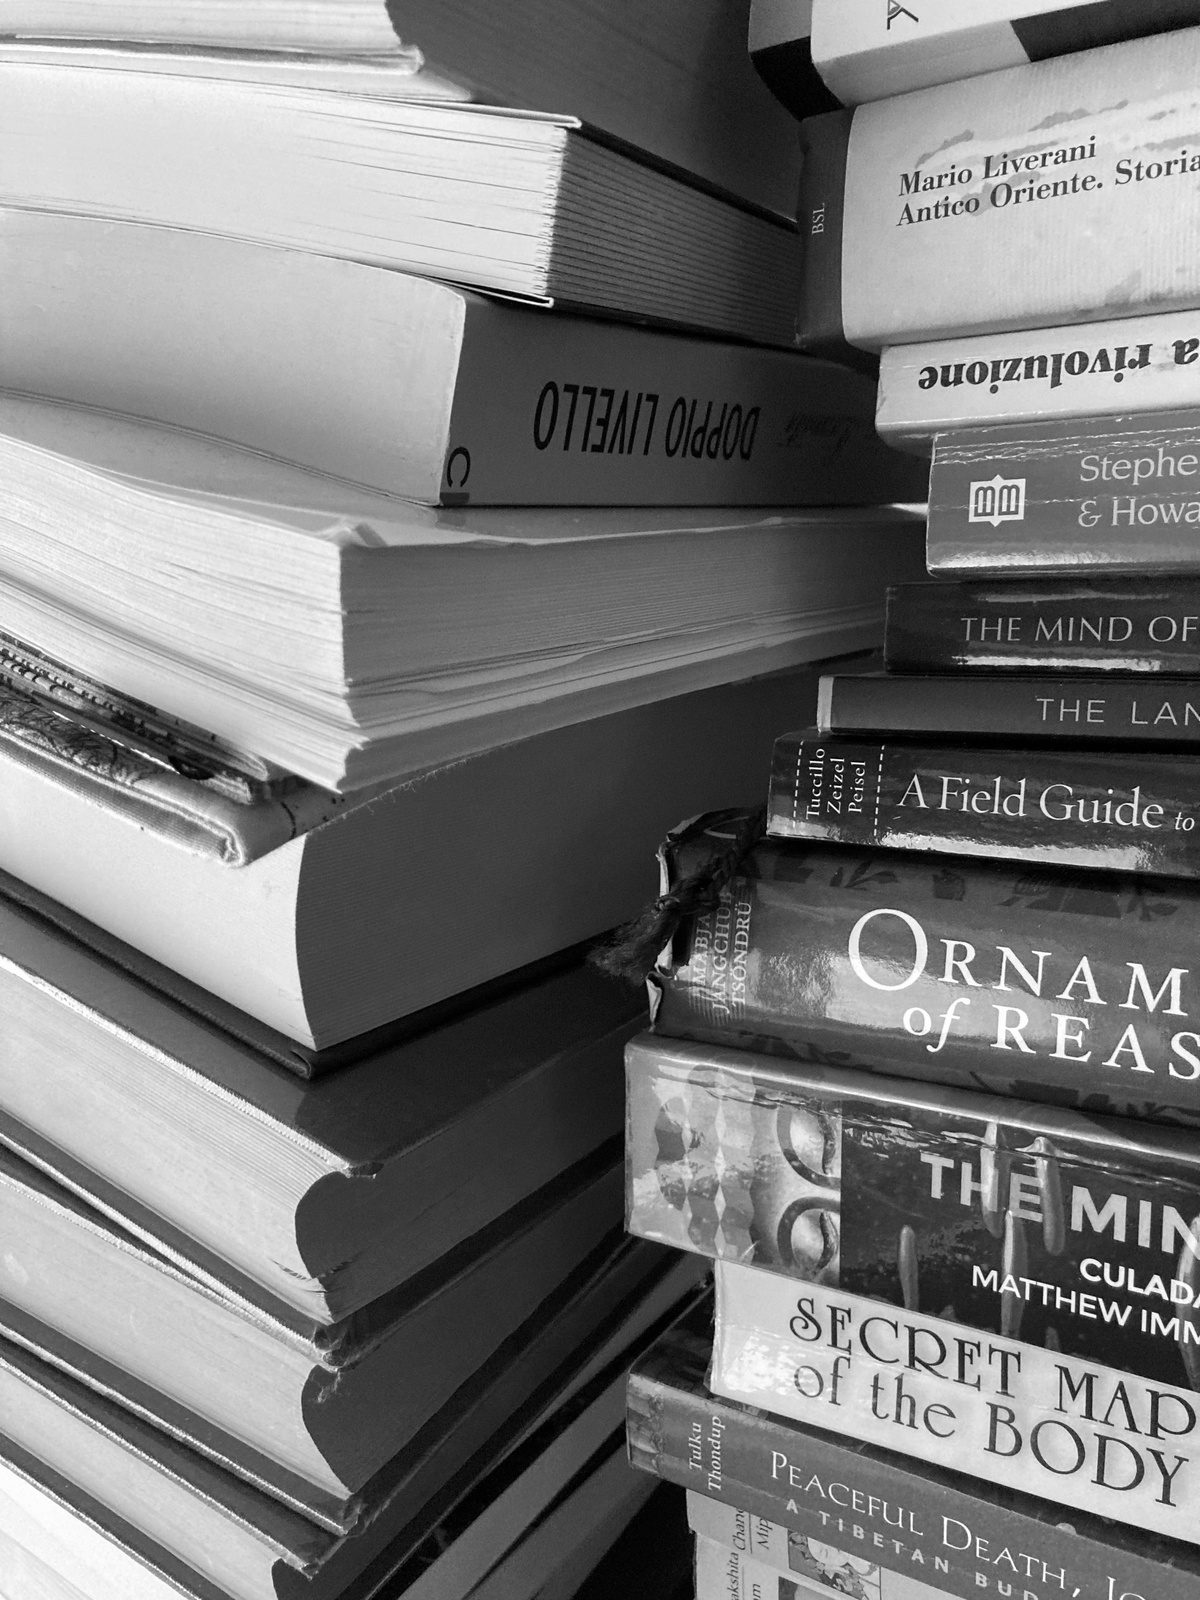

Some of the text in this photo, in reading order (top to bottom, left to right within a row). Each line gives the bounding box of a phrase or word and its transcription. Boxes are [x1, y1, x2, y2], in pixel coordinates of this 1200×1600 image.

[898, 135, 1097, 197] Mario Liverani
[811, 201, 826, 235] BSL
[896, 195, 981, 227] Antico
[989, 174, 1104, 208] Oriente.
[918, 343, 1153, 394] rivoluzione
[533, 381, 660, 457] LIVELLO
[664, 396, 762, 461] DOPPIO
[1080, 447, 1199, 486] Stephe
[1078, 500, 1102, 528] &
[960, 615, 1200, 643] THE MIND OF
[1036, 698, 1106, 723] THE
[805, 747, 826, 820] Tuccillo
[826, 757, 846, 815] Zeizel
[847, 759, 867, 814] Peisel
[897, 773, 1196, 831] A Field Guide to
[730, 901, 752, 1007] TSÖNDRÜ
[848, 908, 1190, 1017] ORNAM
[902, 997, 1200, 1080] of REAS
[920, 1152, 1046, 1224] THE
[971, 1265, 1133, 1327] MATTHEW
[789, 1297, 1198, 1441] SECRET MAP
[687, 1421, 703, 1472] Tulku
[706, 1415, 726, 1492] Thondup
[793, 1355, 1190, 1509] of the BODY
[768, 1450, 925, 1537] PEACEFUL
[786, 1498, 799, 1515] A
[818, 1509, 950, 1574] TIBETAN
